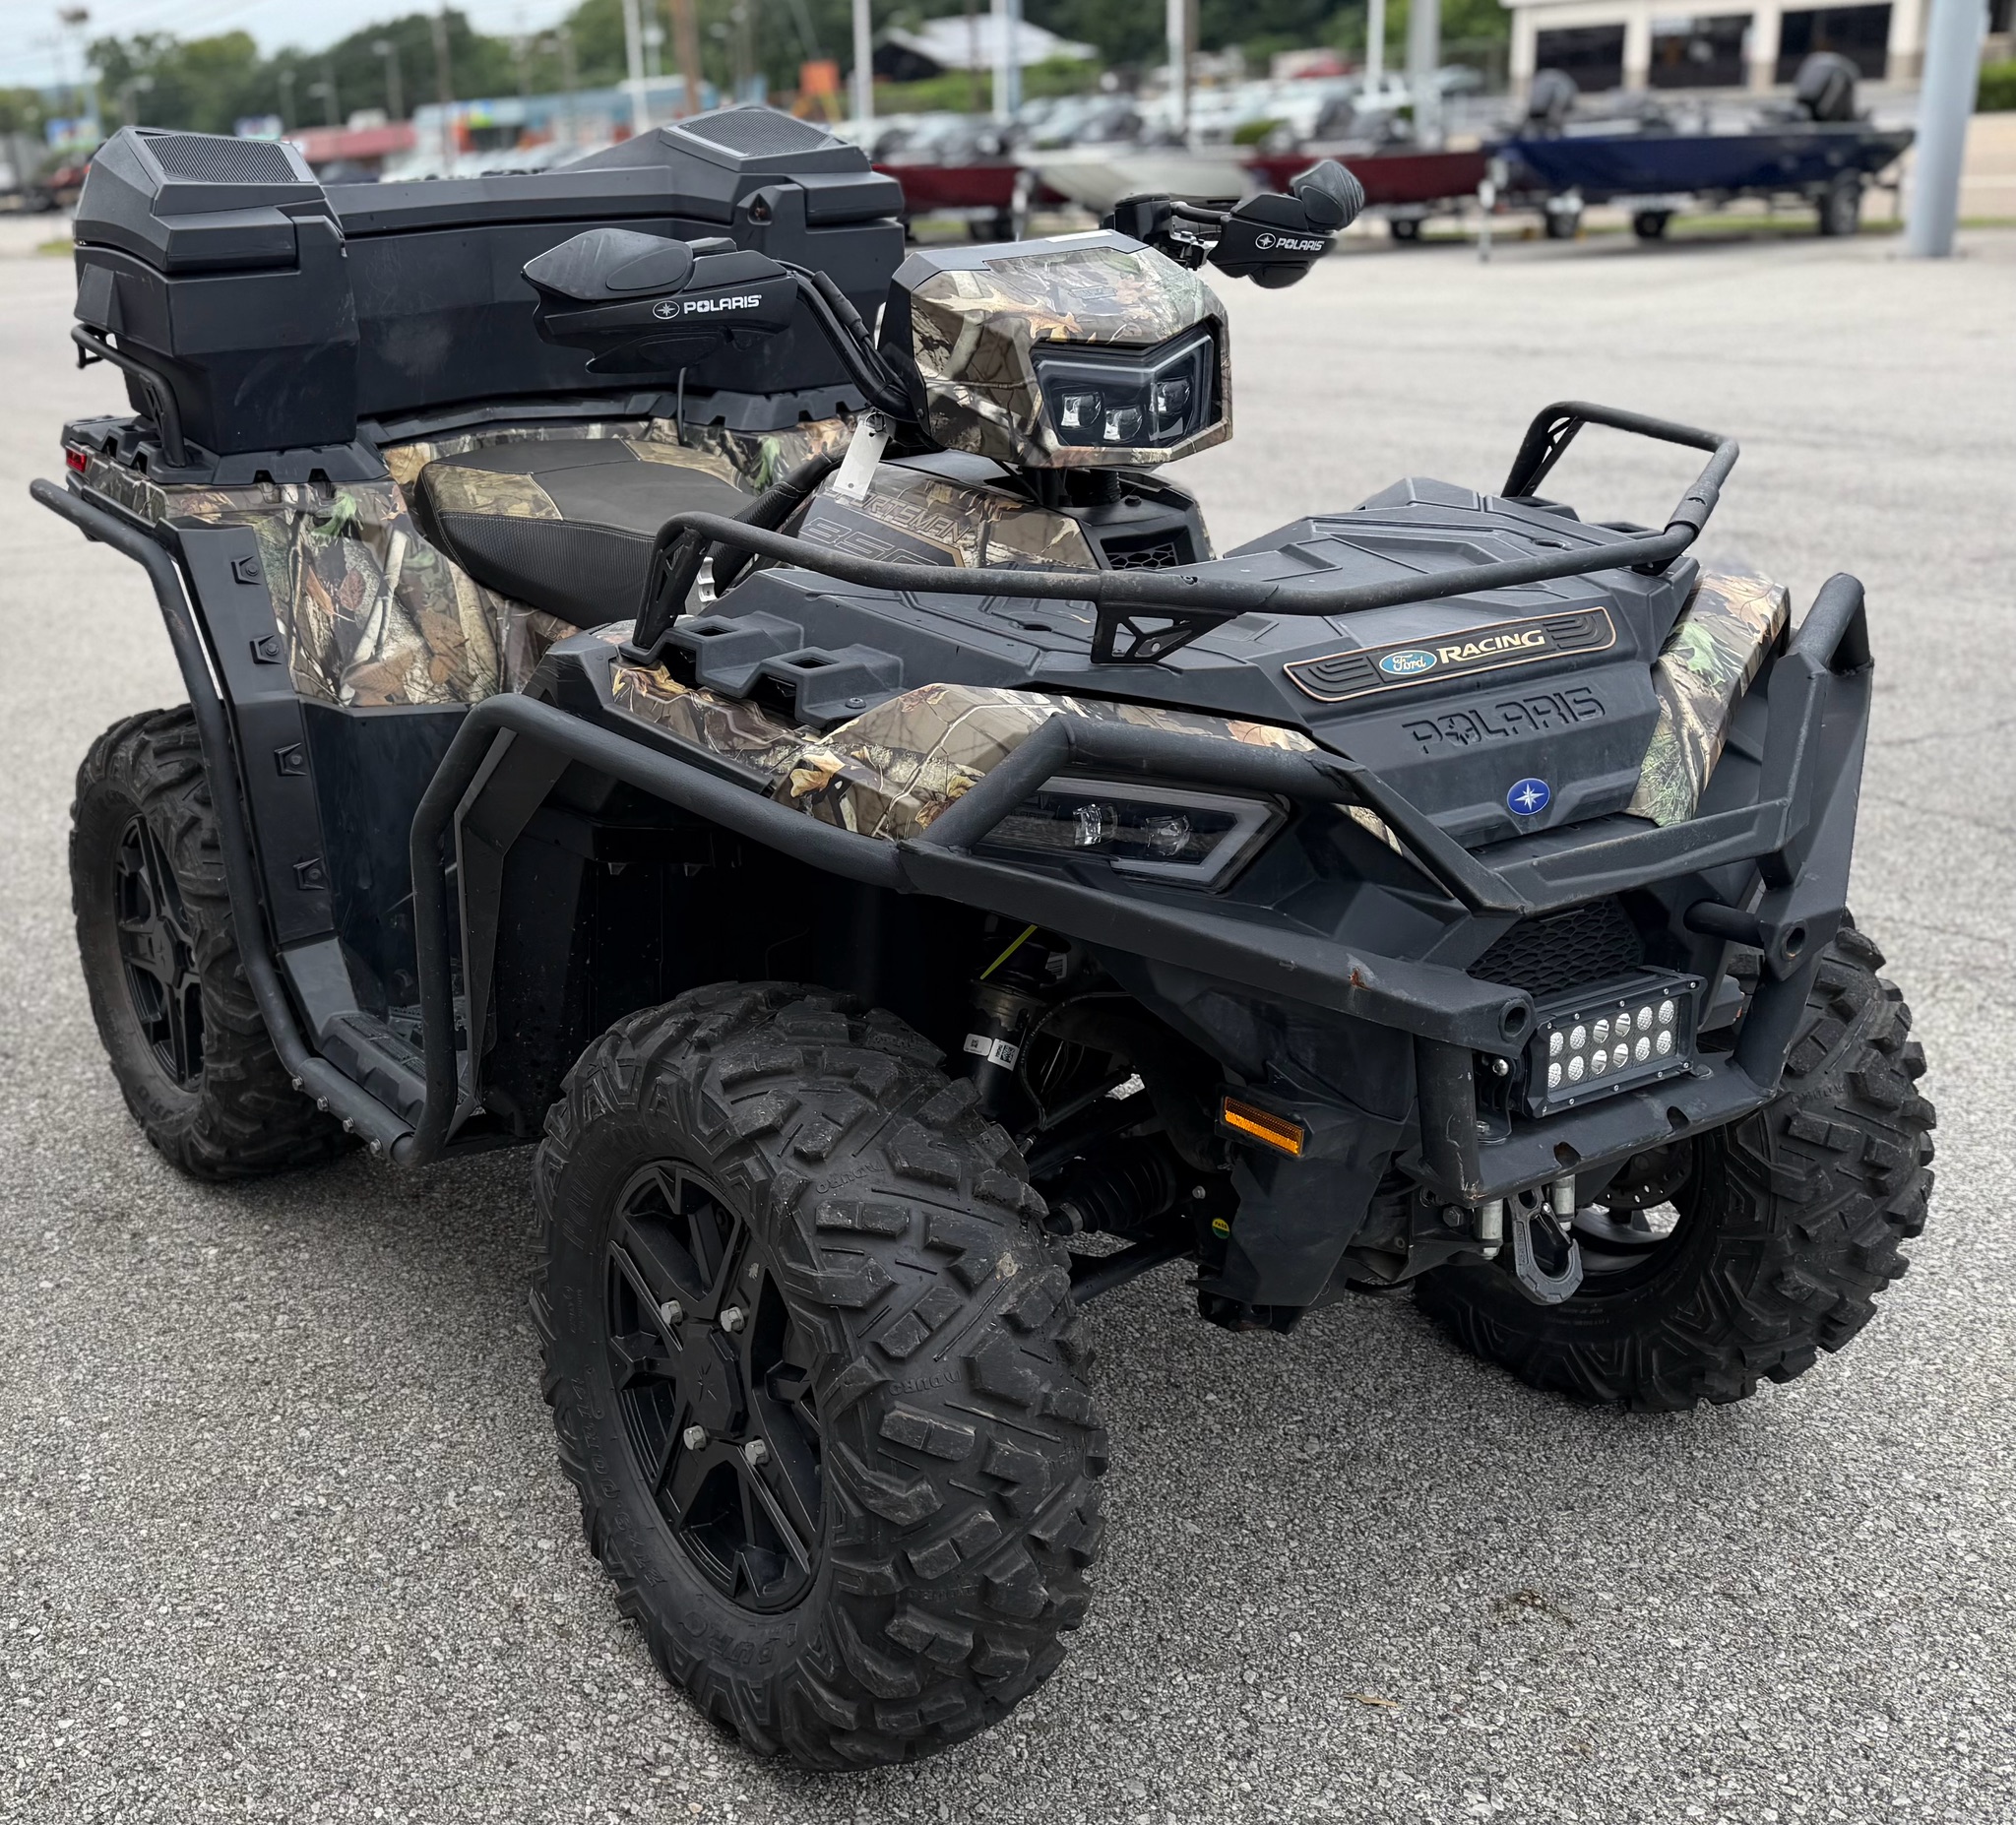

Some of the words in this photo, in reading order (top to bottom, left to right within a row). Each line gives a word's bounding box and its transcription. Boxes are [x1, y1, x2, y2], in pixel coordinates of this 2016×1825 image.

[1276, 237, 1325, 251] POLARIS
[683, 294, 762, 314] POLARIS
[822, 485, 973, 544] SORTSMAN
[1392, 654, 1427, 672] Ford
[1436, 629, 1545, 664] RACING
[1402, 686, 1606, 754] POLARIS
[1214, 1221, 1228, 1229] PASS
